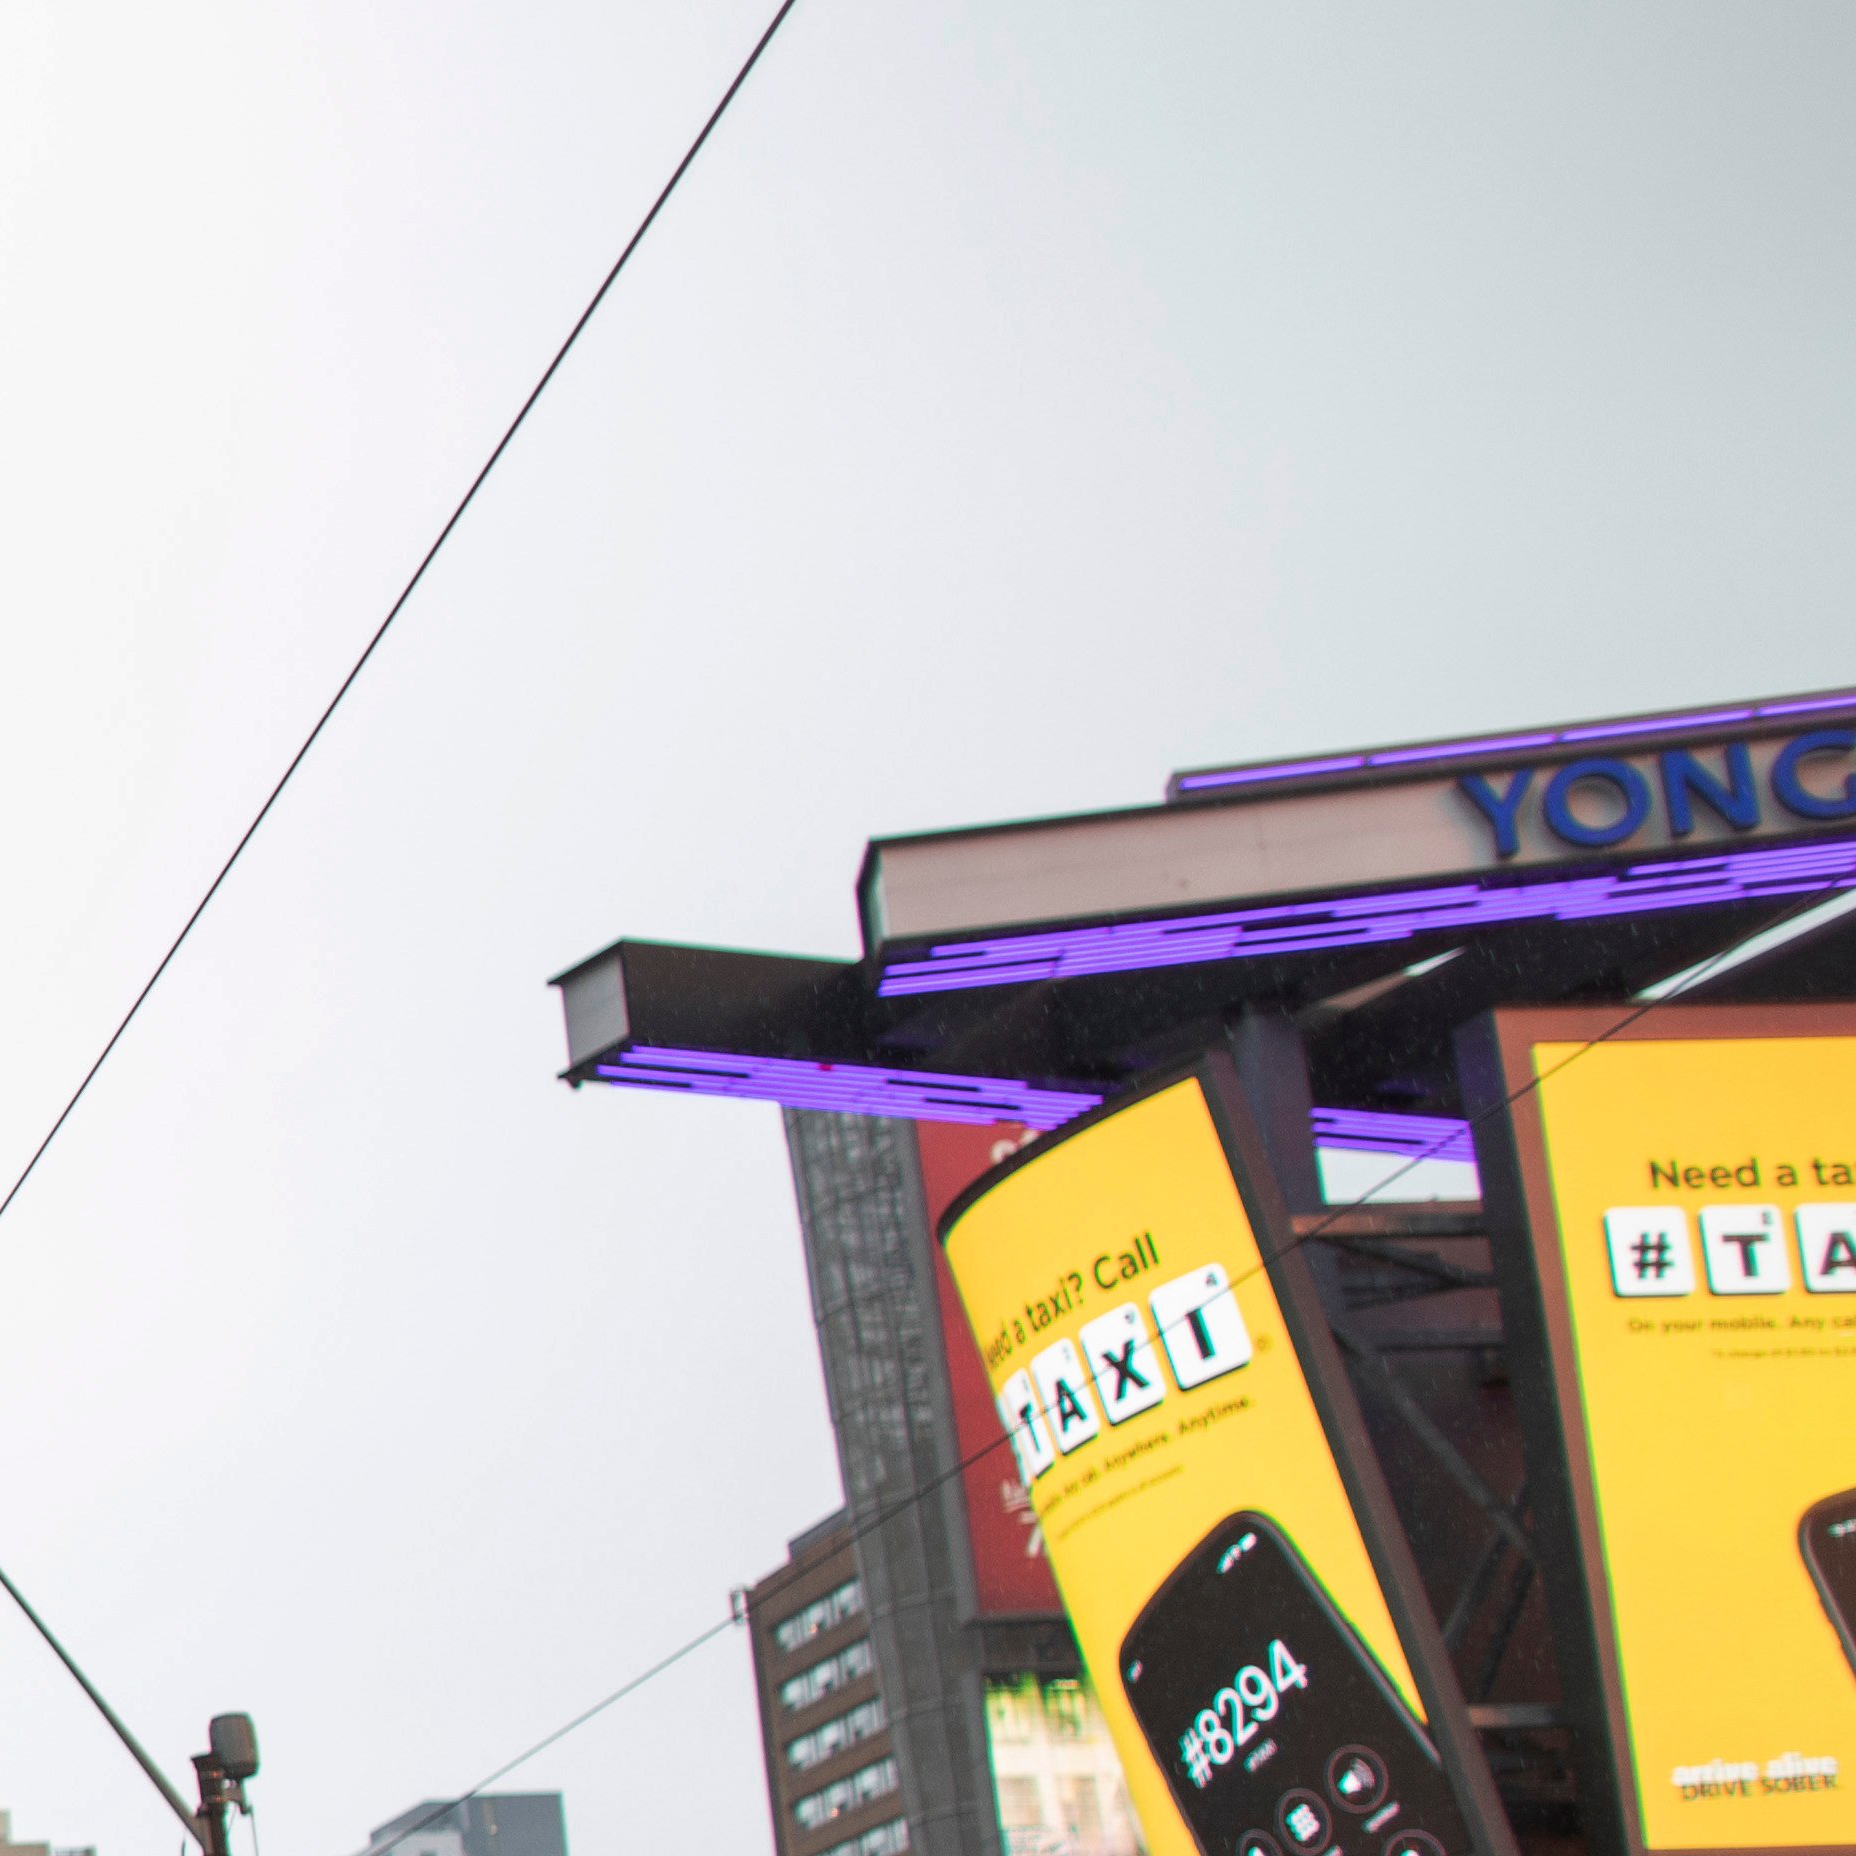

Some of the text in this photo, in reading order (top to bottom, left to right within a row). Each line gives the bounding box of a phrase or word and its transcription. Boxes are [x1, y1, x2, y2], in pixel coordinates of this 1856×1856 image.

[1649, 1157, 1761, 1189] Need
[1776, 1164, 1799, 1187] a
[1026, 1269, 1085, 1333] taxi?
[1092, 1229, 1161, 1291] Call
[1177, 1637, 1309, 1790] #8294
